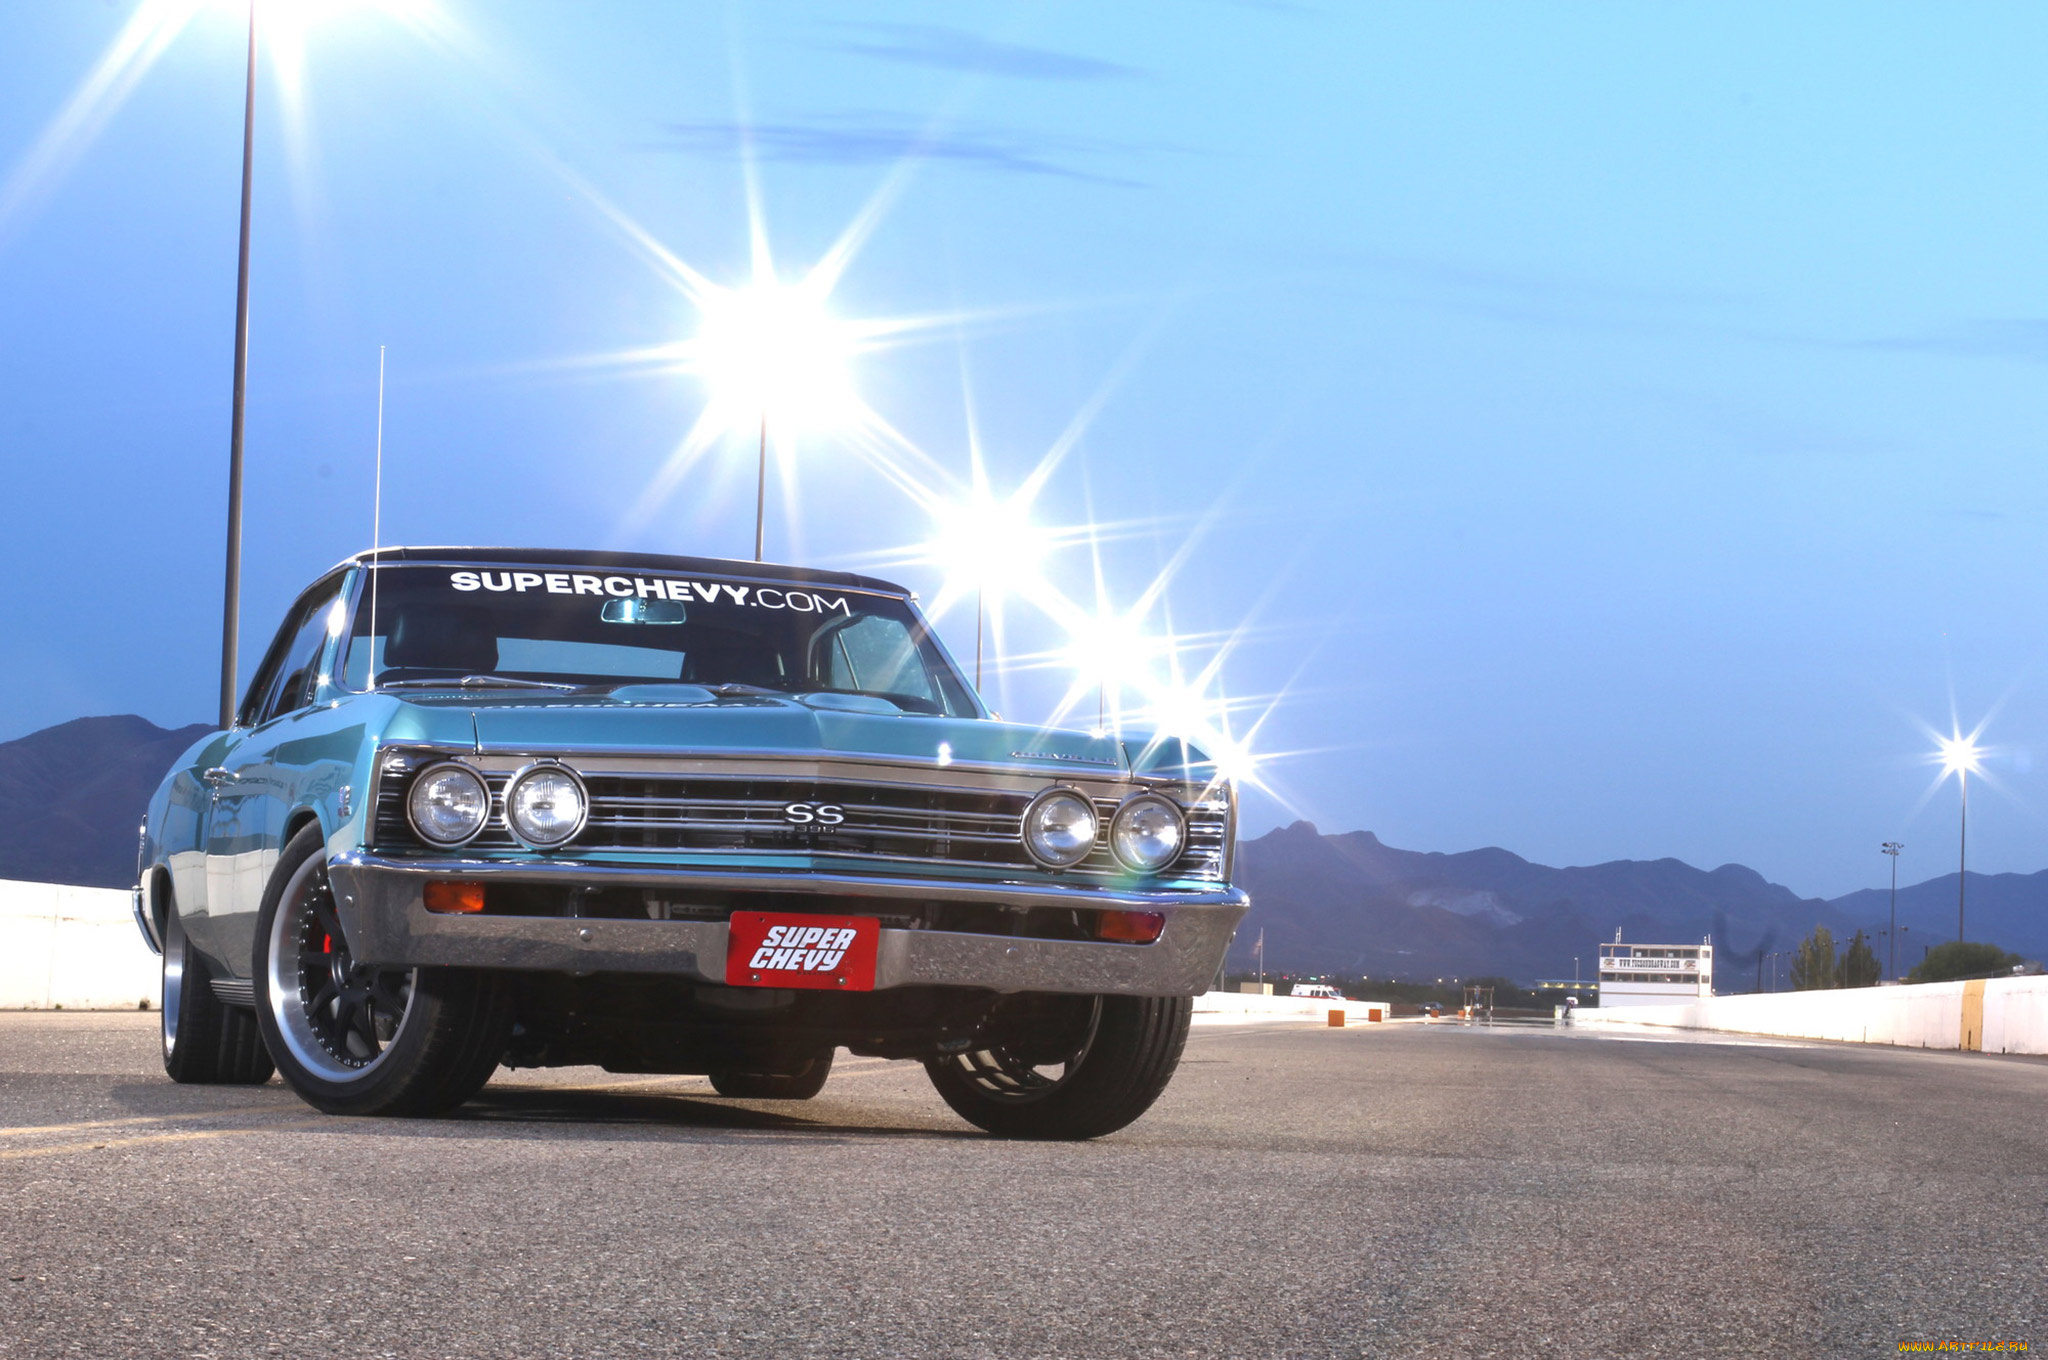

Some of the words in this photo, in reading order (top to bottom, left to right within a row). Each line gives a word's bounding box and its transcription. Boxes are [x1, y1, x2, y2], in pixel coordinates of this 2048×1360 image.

[450, 571, 851, 617] SUPERCHEVY.COM
[785, 804, 844, 824] SS
[762, 926, 857, 949] SUPER
[749, 947, 845, 971] CHEVY
